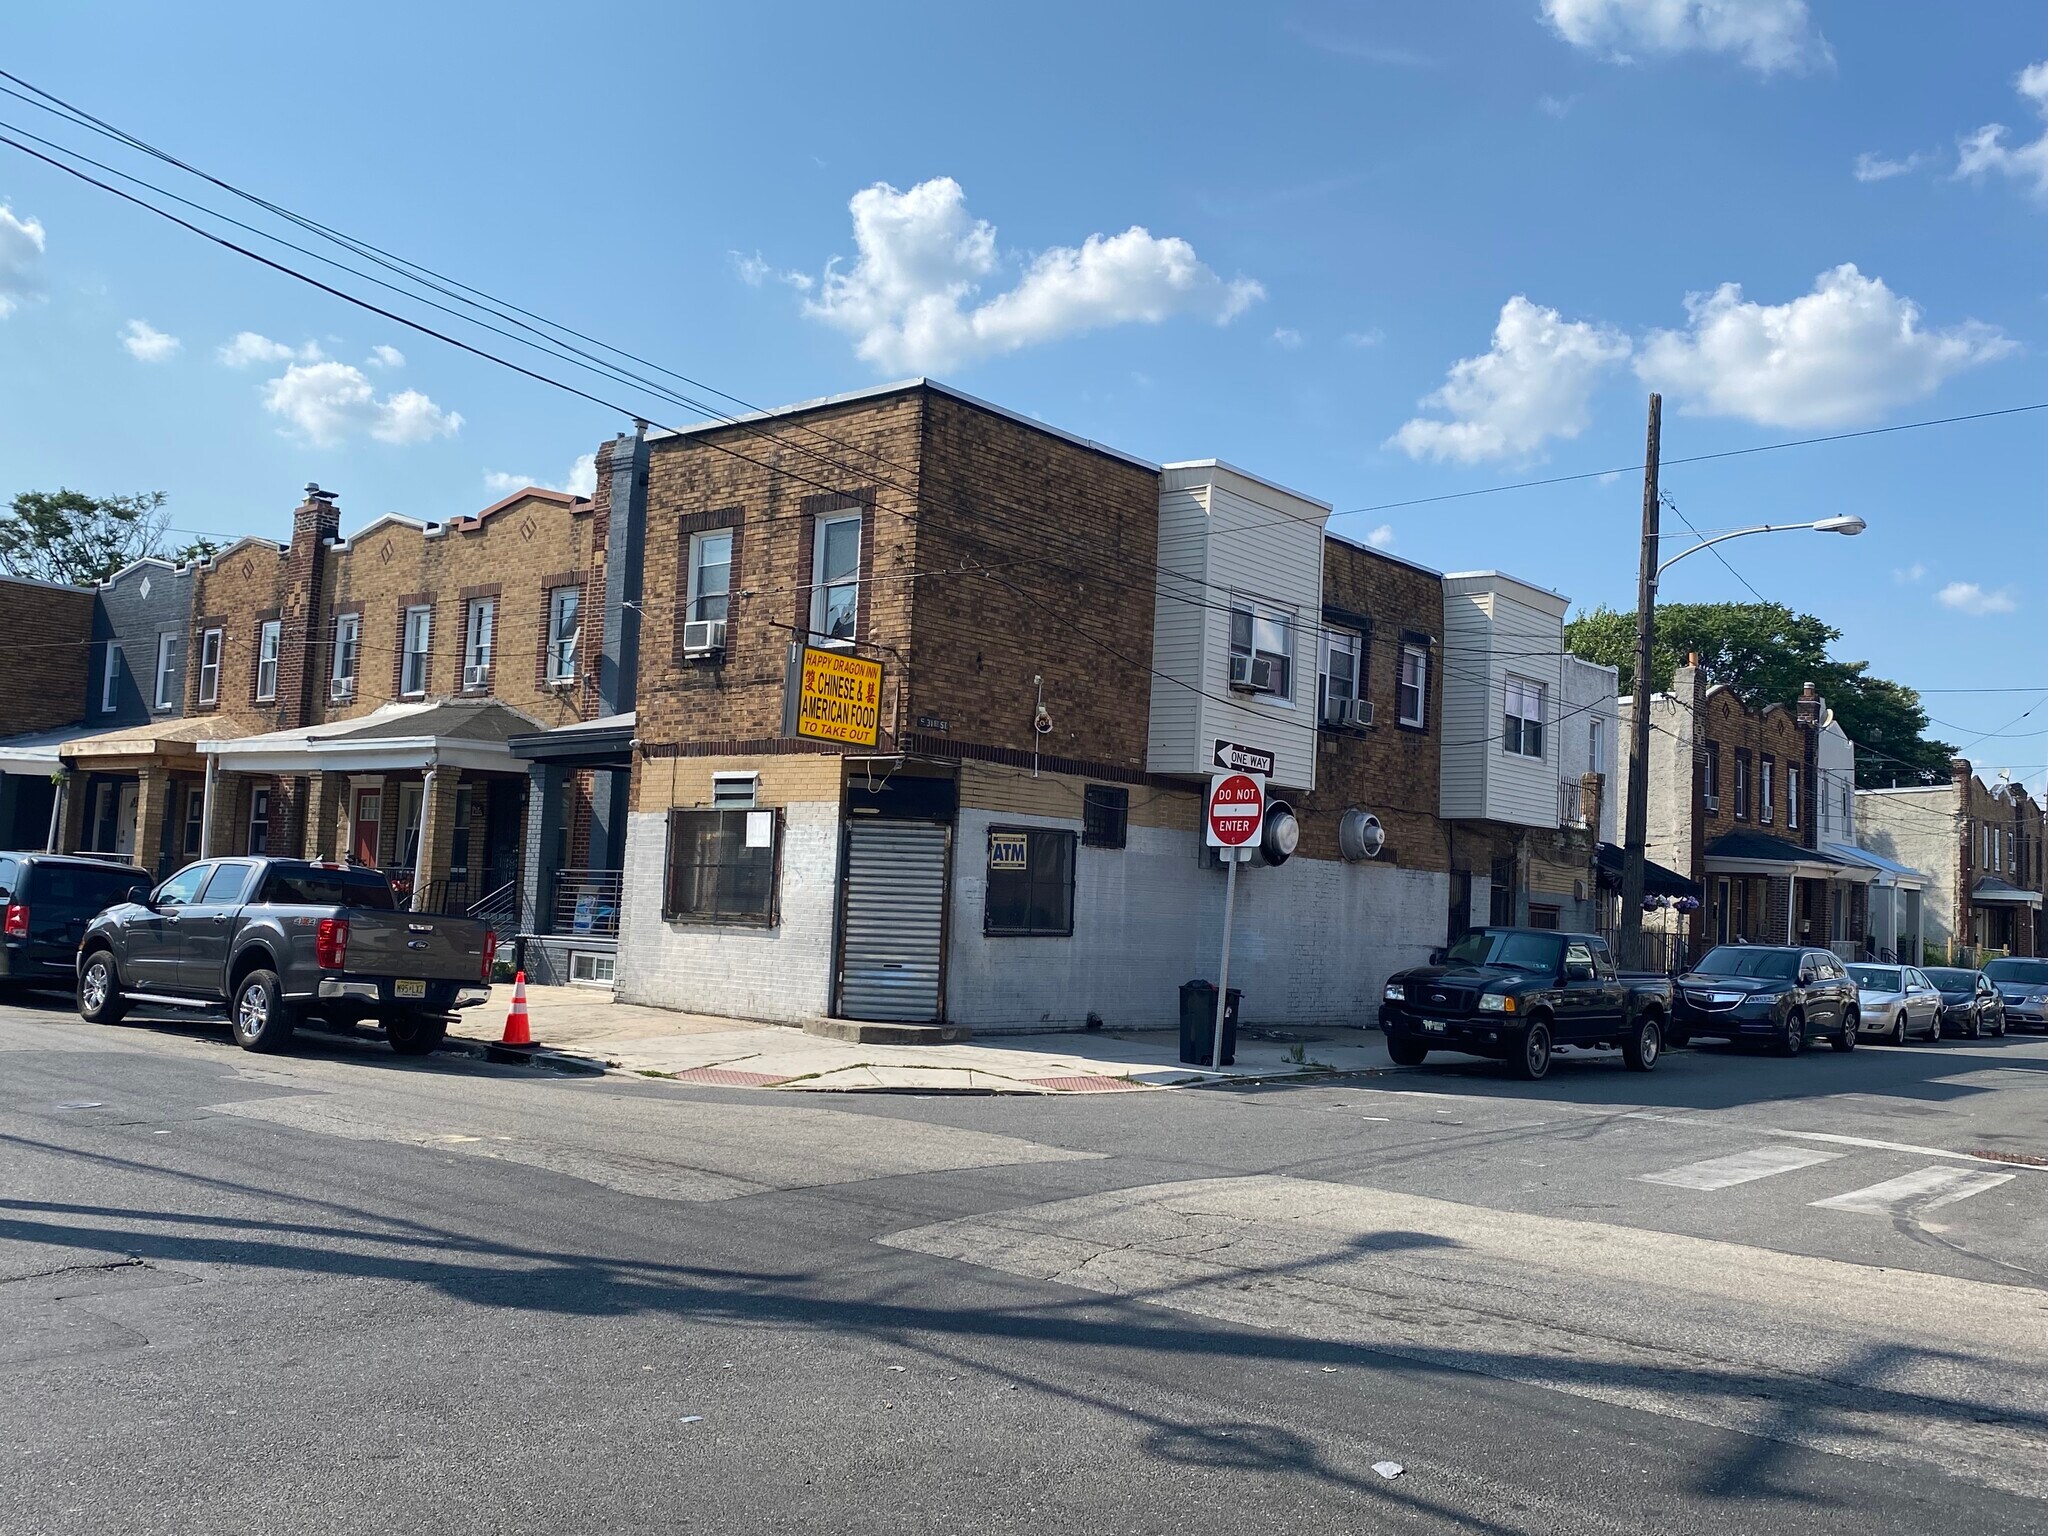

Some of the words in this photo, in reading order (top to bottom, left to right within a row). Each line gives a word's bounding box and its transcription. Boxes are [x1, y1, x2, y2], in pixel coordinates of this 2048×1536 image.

[806, 653, 834, 669] HAPPY
[833, 659, 865, 677] DRAGON
[865, 667, 879, 679] INN
[817, 672, 855, 701] CHINESE
[856, 680, 863, 702] &
[801, 695, 850, 724] AMERICAN
[850, 705, 875, 729] FOOD
[804, 721, 818, 732] TO
[821, 724, 847, 737] TAKE
[849, 729, 871, 741] OUT
[1231, 751, 1248, 765] ONE
[1250, 755, 1268, 768] WAY
[1218, 789, 1232, 800] DO
[1236, 789, 1255, 800] NOT
[1219, 820, 1249, 831] ENTER
[993, 843, 1025, 861] ATM
